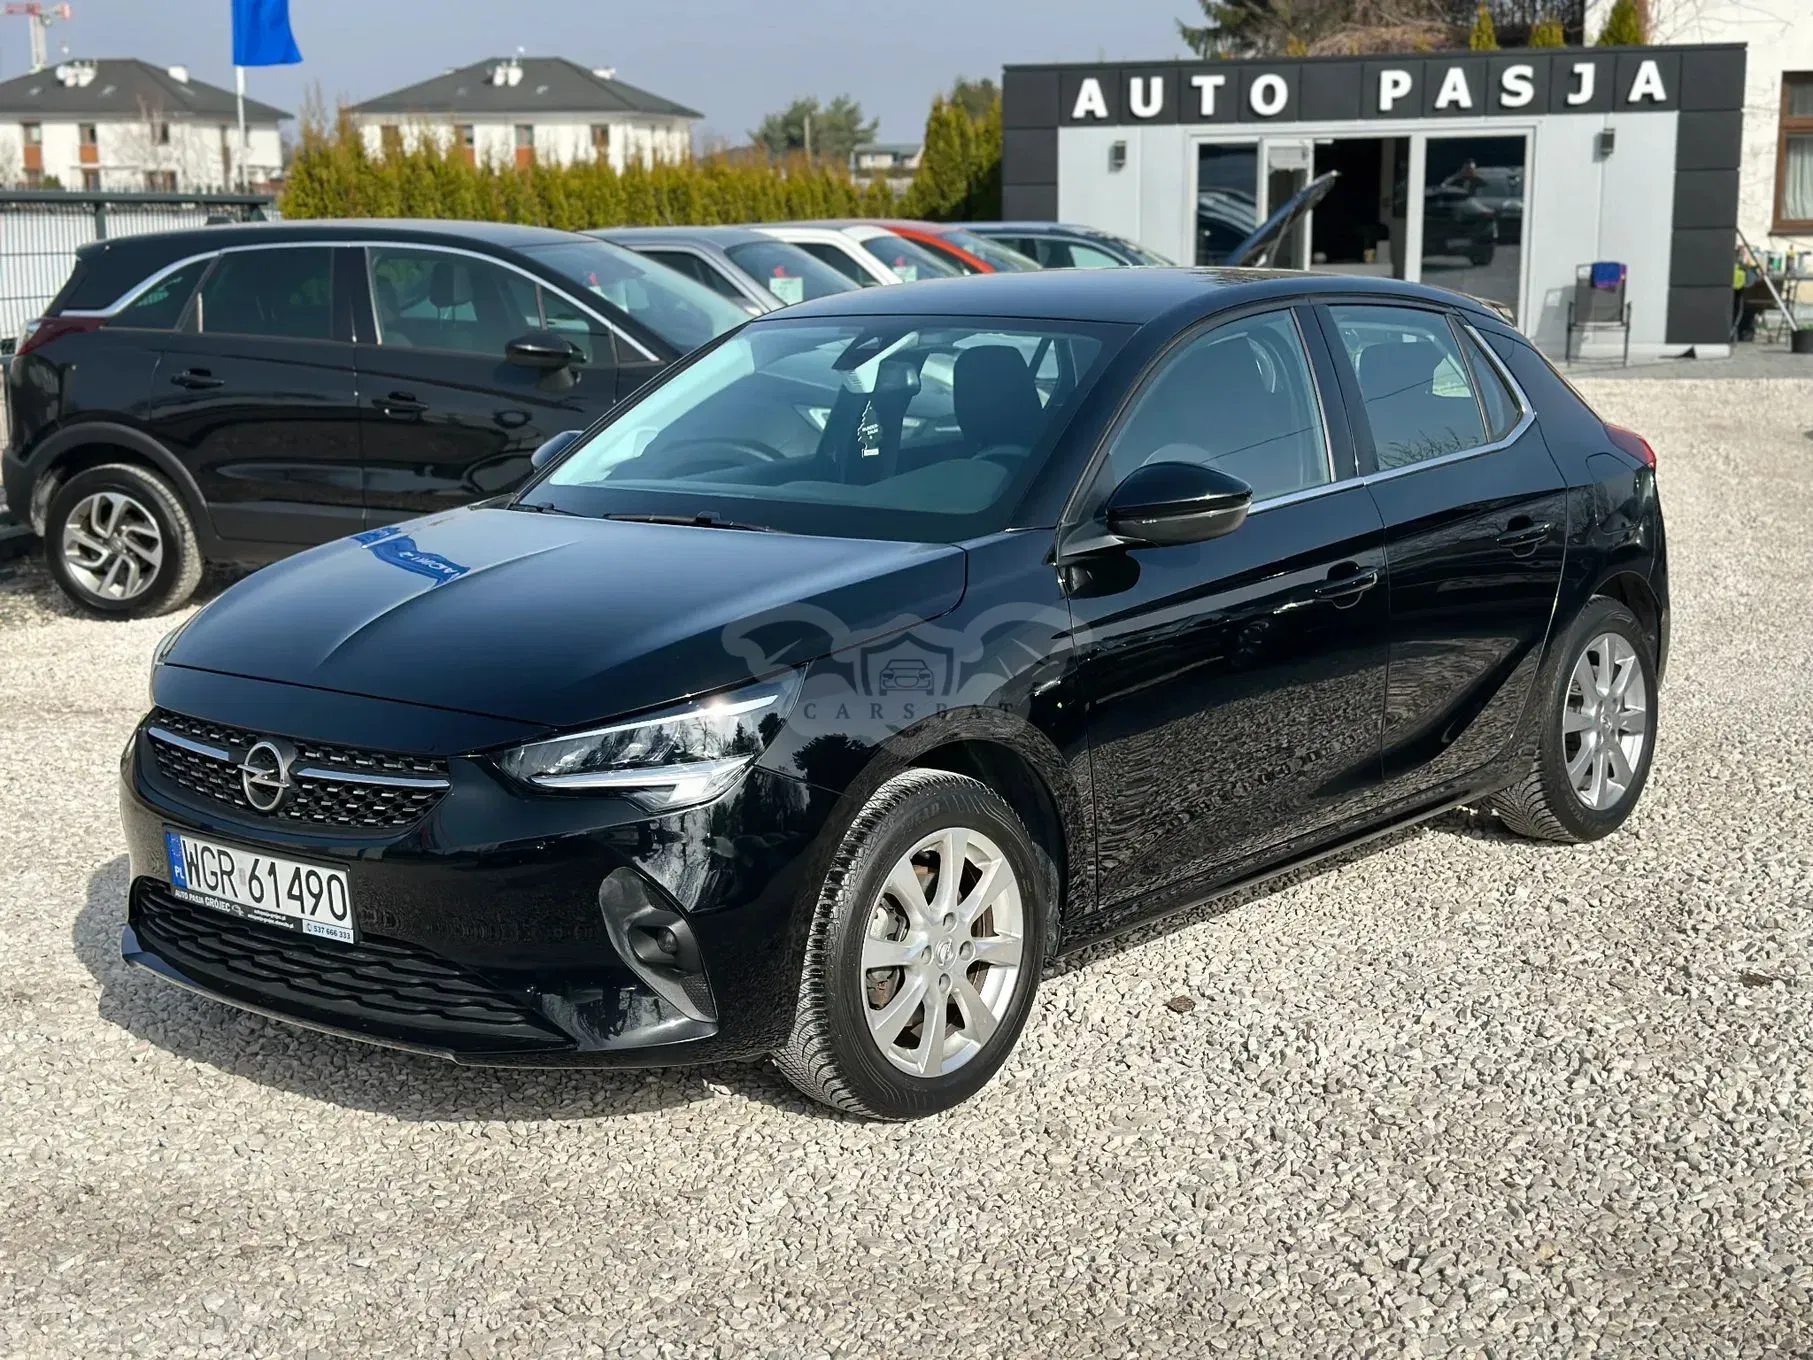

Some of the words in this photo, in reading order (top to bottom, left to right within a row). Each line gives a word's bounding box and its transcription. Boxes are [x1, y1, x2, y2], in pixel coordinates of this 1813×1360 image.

[1072, 73, 1288, 118] AUTO
[1379, 60, 1667, 111] PASJA
[174, 865, 185, 879] PL
[182, 839, 238, 898] WGR
[248, 858, 347, 921] 61490
[205, 896, 231, 912] GRÓJEC
[313, 925, 325, 934] 537
[325, 928, 338, 937] 666
[339, 930, 351, 940] 333
